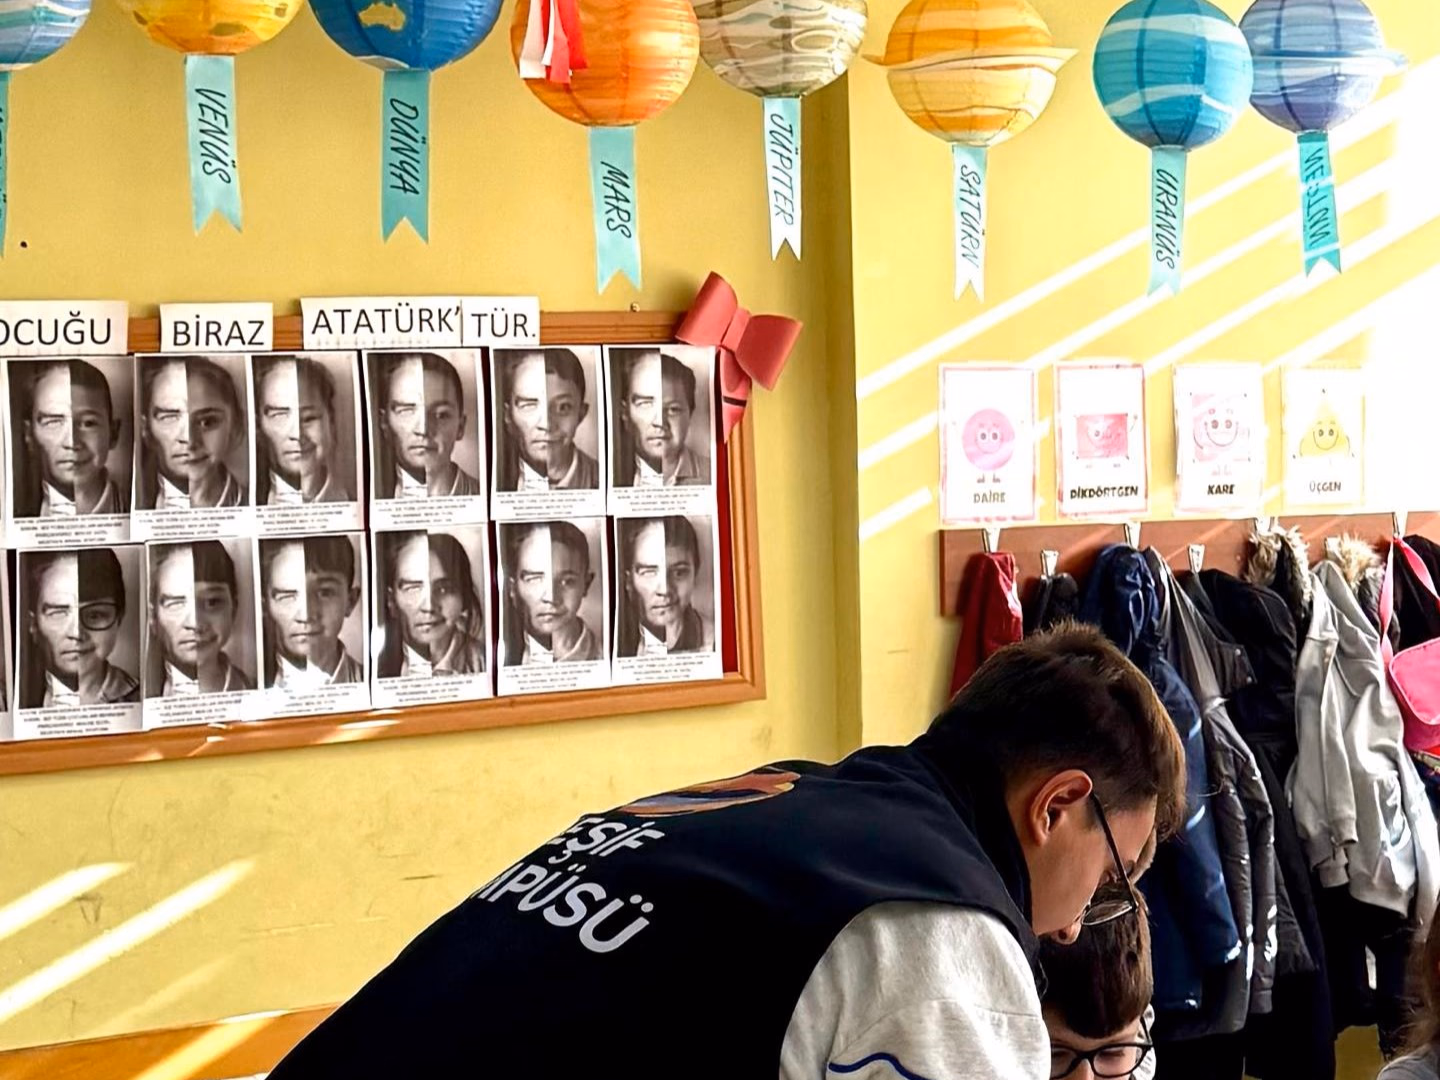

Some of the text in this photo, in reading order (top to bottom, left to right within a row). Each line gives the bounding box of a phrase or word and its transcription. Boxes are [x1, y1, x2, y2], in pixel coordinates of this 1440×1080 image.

[194, 87, 237, 184] VENÜS
[388, 97, 427, 196] DÜNYA
[599, 160, 632, 239] MARS
[173, 314, 265, 346] BİRAZ
[471, 307, 537, 337] TÜR.
[1207, 484, 1235, 495] KARE
